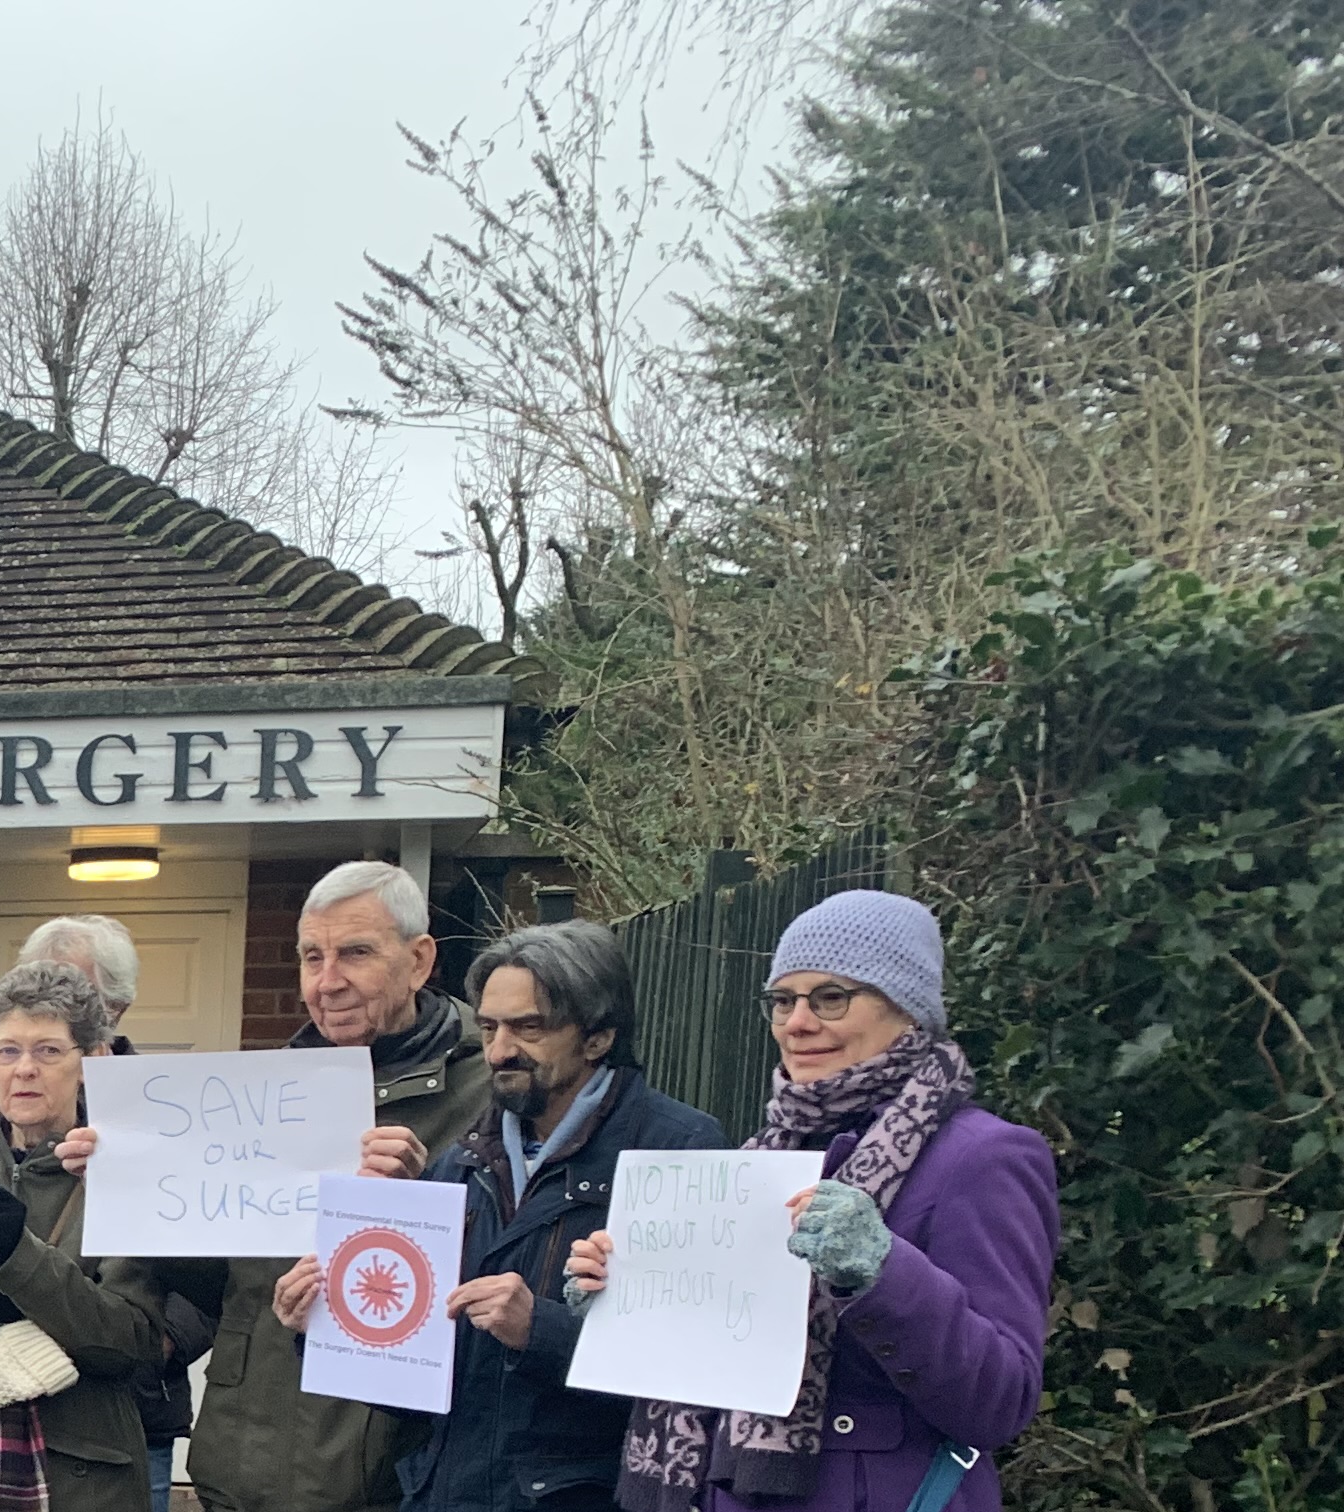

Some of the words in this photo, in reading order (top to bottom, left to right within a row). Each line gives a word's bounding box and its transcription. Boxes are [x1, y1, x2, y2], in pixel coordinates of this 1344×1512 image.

[143, 1074, 308, 1138] SAVE
[204, 1140, 278, 1166] OUR
[157, 1174, 320, 1222] SURGE
[624, 1160, 753, 1212] NOTHING
[323, 1208, 334, 1218] No
[336, 1210, 393, 1225] Environmental
[393, 1217, 422, 1229] Impact
[423, 1221, 452, 1234] Survey
[627, 1220, 697, 1256] ABOUT
[712, 1214, 737, 1250] US
[615, 1267, 717, 1316] WITHOUT
[725, 1279, 759, 1342] US
[308, 1339, 322, 1349] The
[323, 1342, 353, 1355] Surgery
